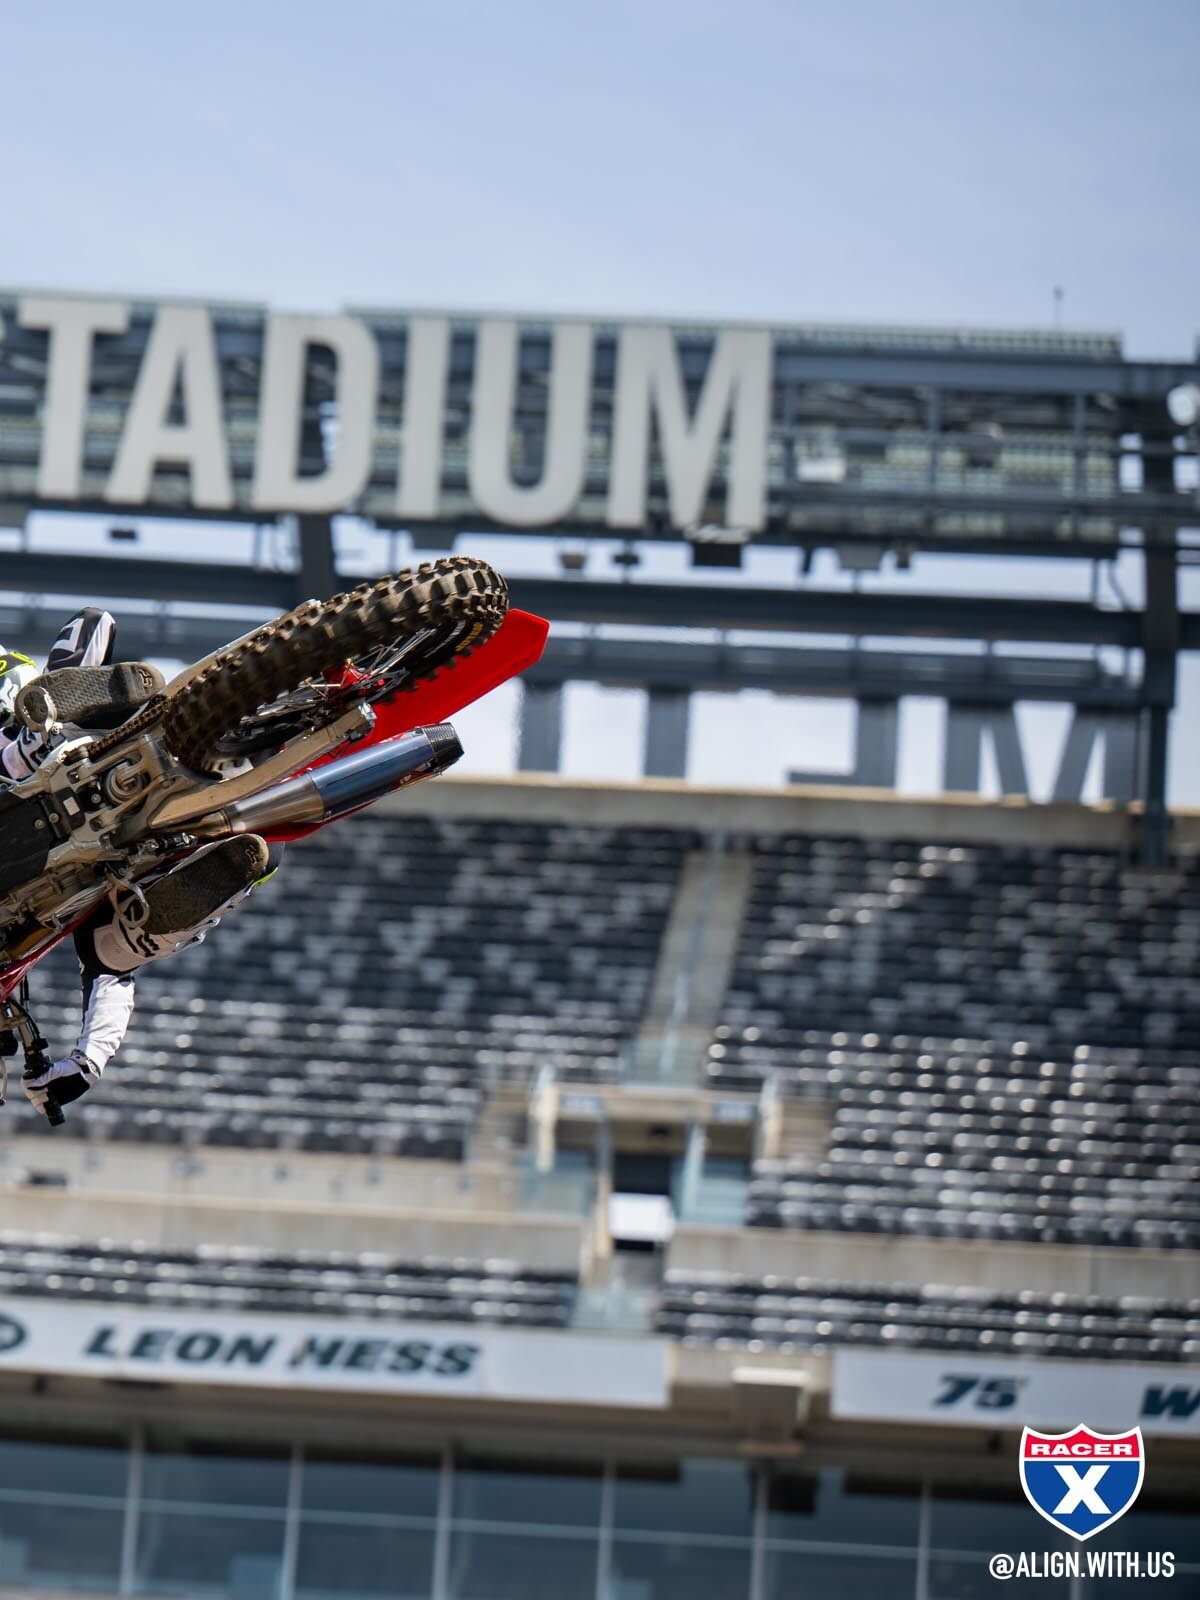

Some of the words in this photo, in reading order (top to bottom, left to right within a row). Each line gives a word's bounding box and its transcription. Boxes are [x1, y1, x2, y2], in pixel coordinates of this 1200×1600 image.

[83, 1326, 277, 1367] LEON
[288, 1337, 481, 1377] HESS
[934, 1375, 1022, 1409] 75
